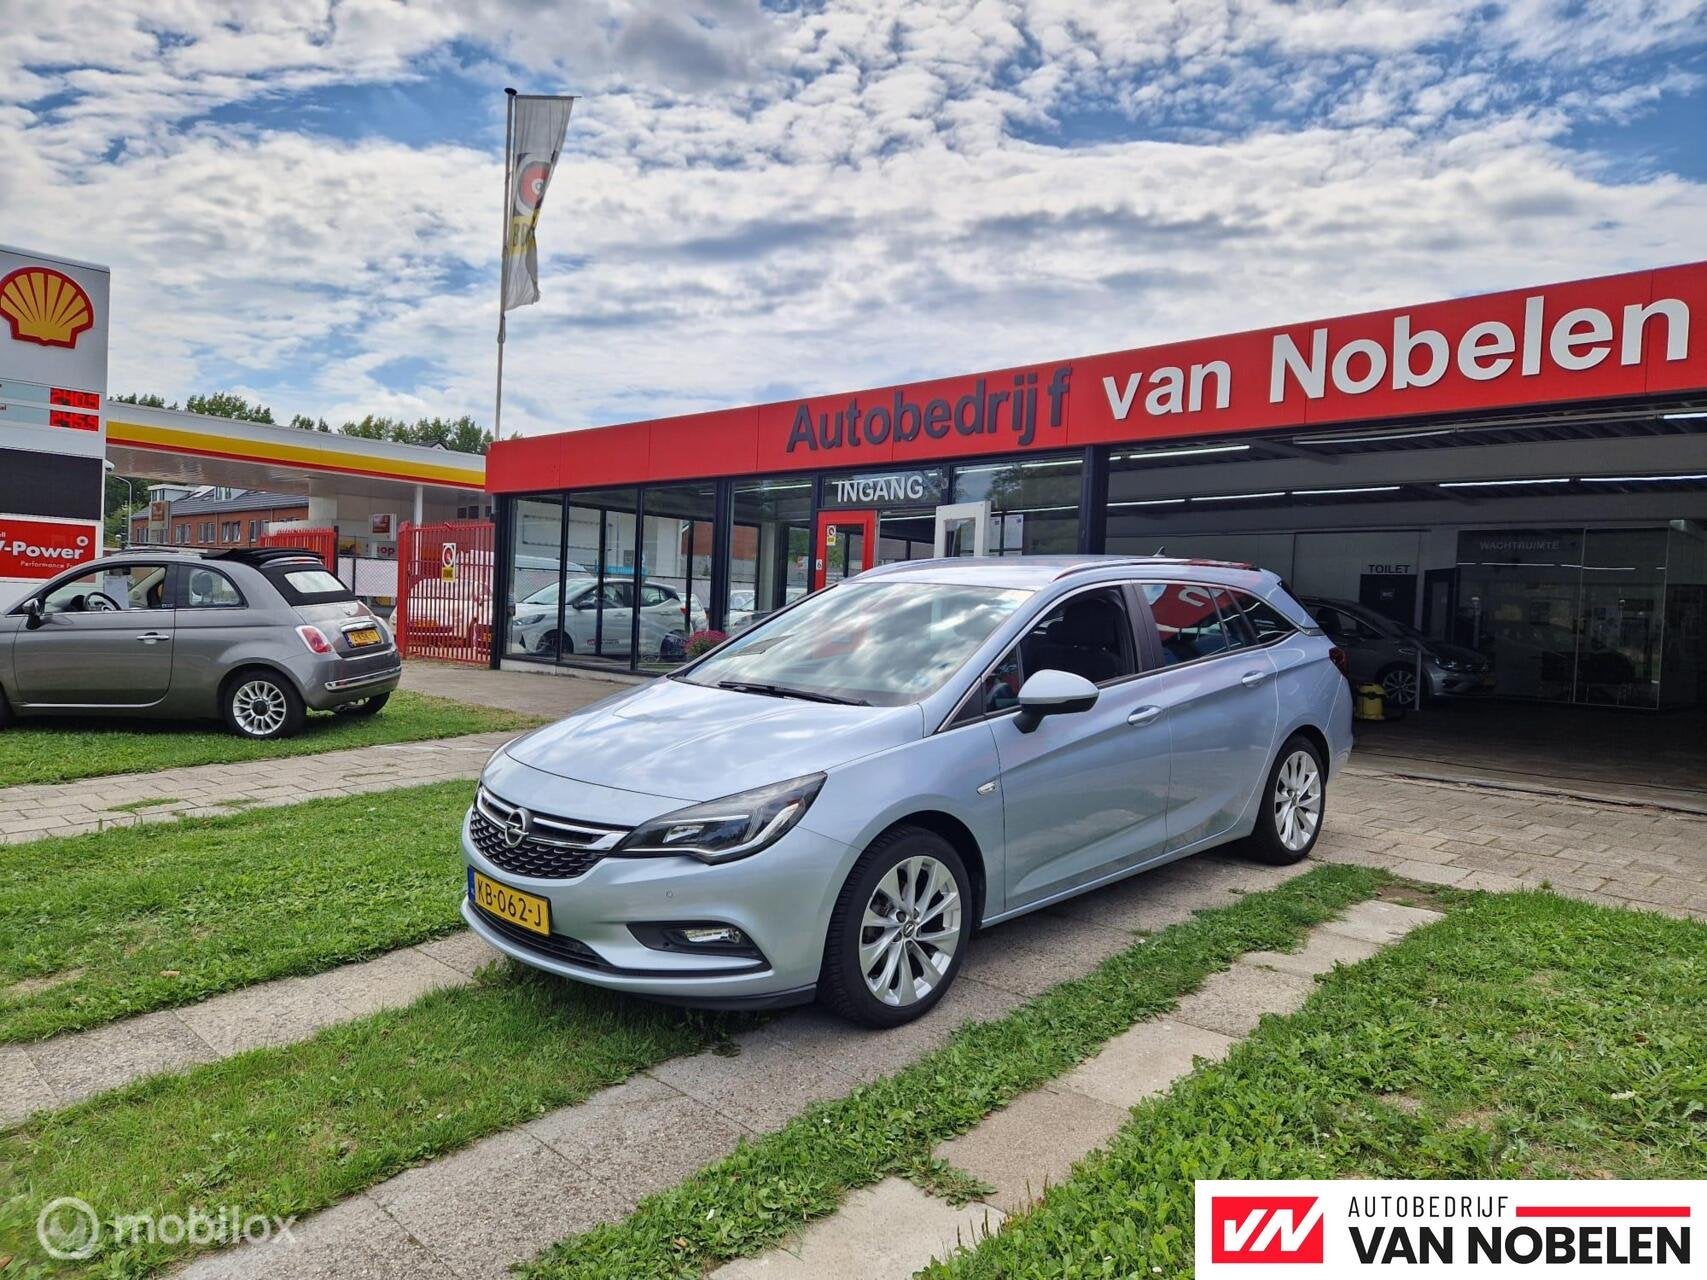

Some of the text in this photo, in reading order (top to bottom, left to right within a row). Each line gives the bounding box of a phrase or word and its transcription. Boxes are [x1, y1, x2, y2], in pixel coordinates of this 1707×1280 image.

[786, 295, 1690, 453] Autobedrijf van Nobelen
[837, 475, 924, 502] INGANG
[1368, 564, 1410, 574] TOILET
[477, 878, 542, 927] KB-062-J
